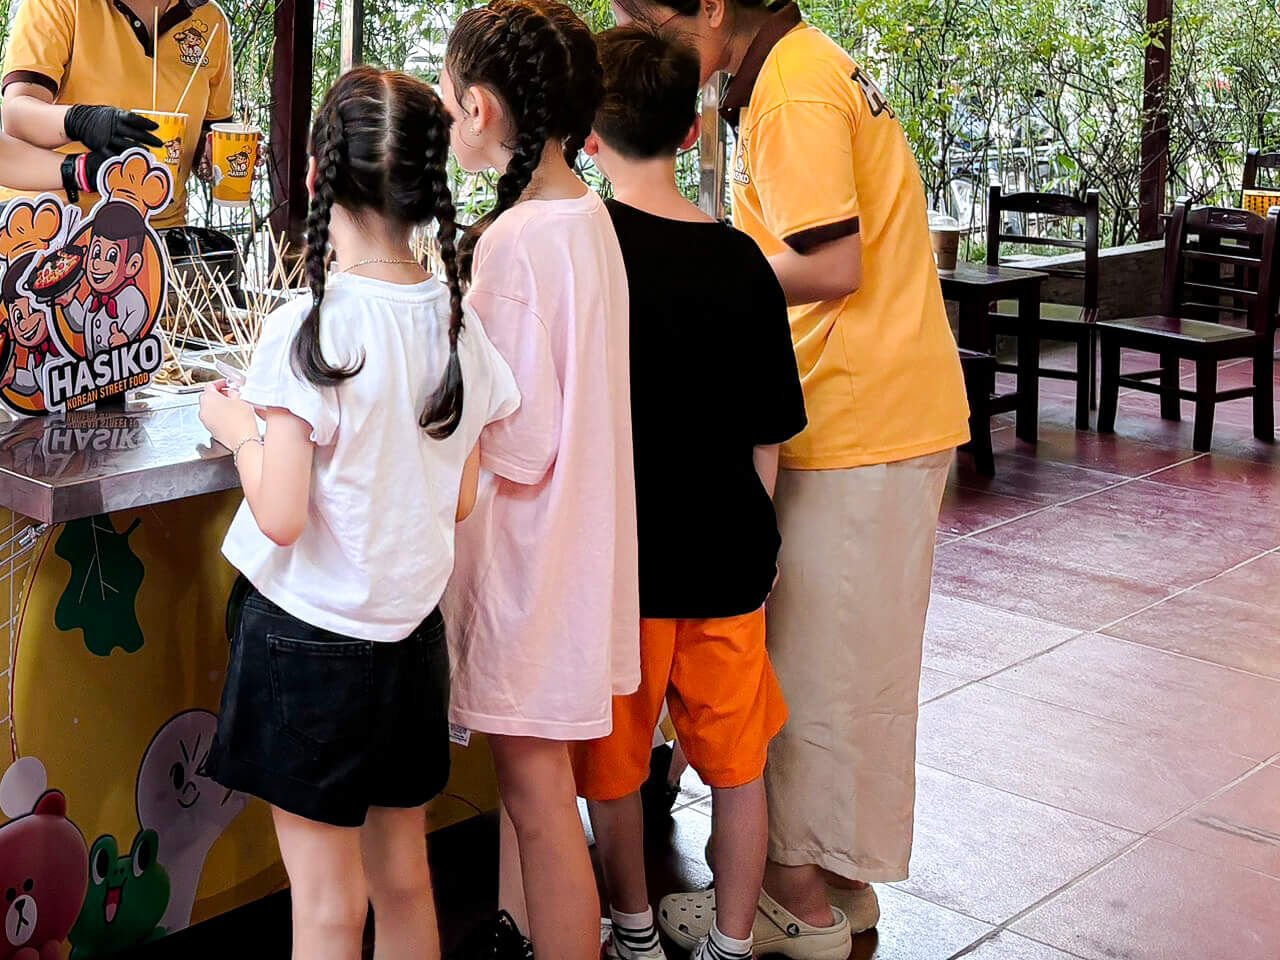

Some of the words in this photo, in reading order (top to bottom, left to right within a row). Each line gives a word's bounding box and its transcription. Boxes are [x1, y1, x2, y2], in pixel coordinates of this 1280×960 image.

[51, 337, 159, 403] HASIKO
[66, 390, 99, 410] KOREAN
[99, 380, 128, 399] STREET
[128, 371, 150, 389] FOOD
